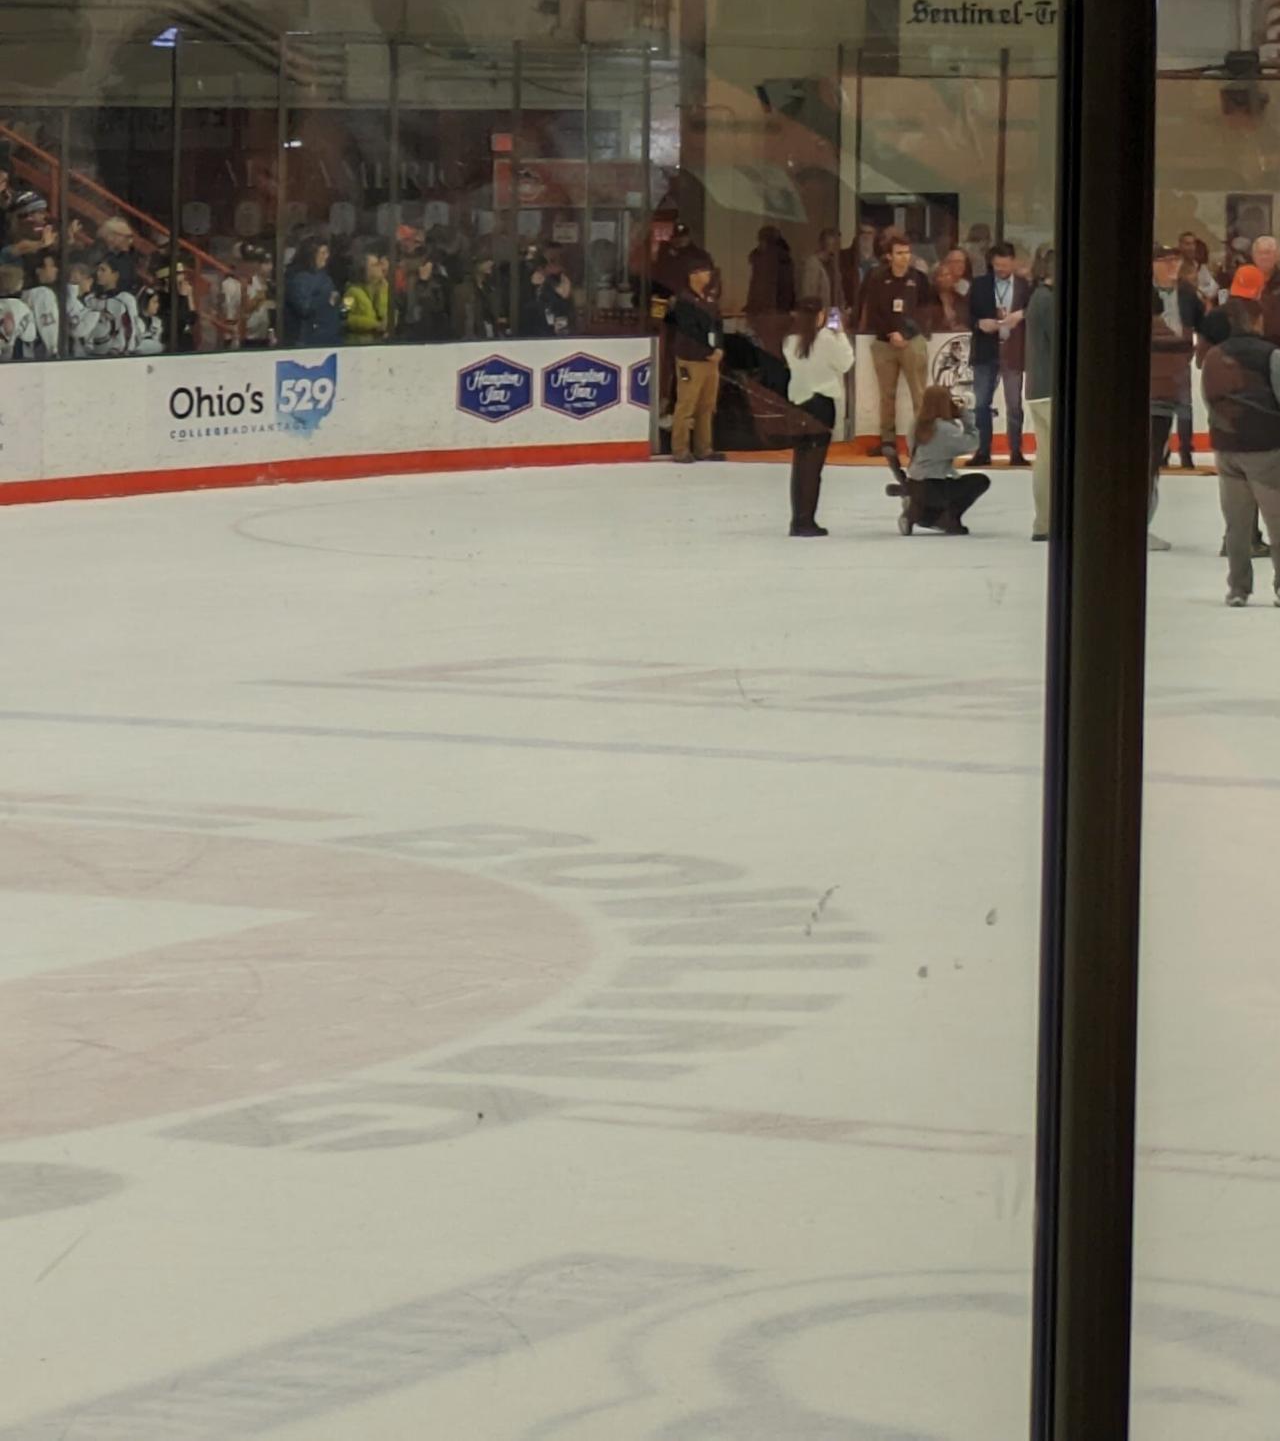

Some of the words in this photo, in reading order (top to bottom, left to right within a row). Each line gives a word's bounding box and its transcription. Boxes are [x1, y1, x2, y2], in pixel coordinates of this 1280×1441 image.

[466, 369, 524, 391] Hampton
[550, 366, 612, 388] Hampton
[169, 382, 264, 420] Ohio's
[278, 377, 335, 414] 529
[479, 386, 511, 405] Inn
[563, 384, 597, 402] Inn
